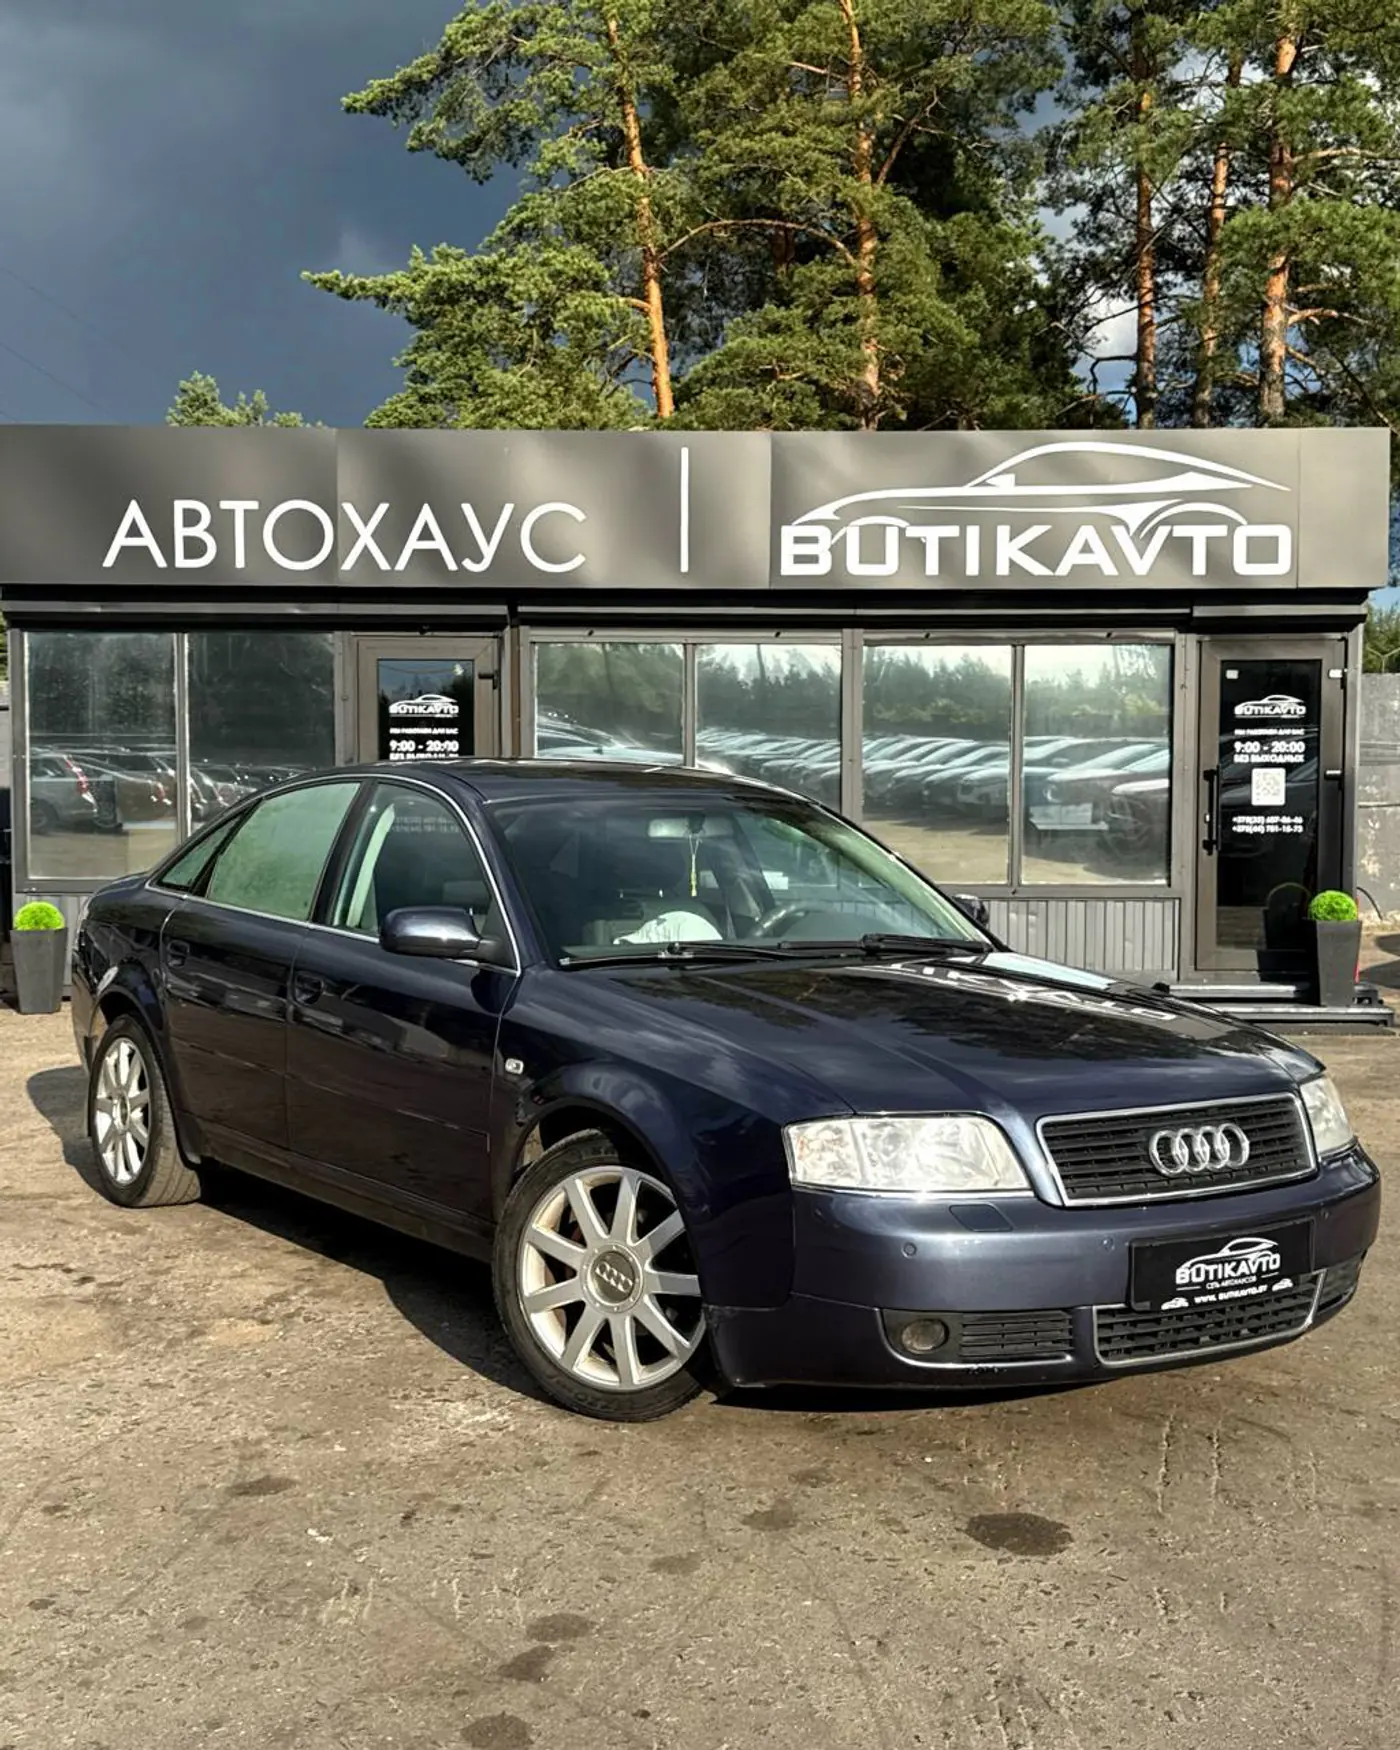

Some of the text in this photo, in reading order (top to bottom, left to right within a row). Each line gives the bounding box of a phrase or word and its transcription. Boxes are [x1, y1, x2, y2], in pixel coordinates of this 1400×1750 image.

[103, 499, 587, 573] АВТОХАУС
[780, 523, 1292, 577] BUTIKAVTO
[389, 739, 415, 752] 9:00
[425, 739, 459, 752] 20:00
[1234, 741, 1260, 753] 9:00
[1271, 741, 1305, 753] 20:00
[1175, 1253, 1281, 1285] BUTIKAVTO
